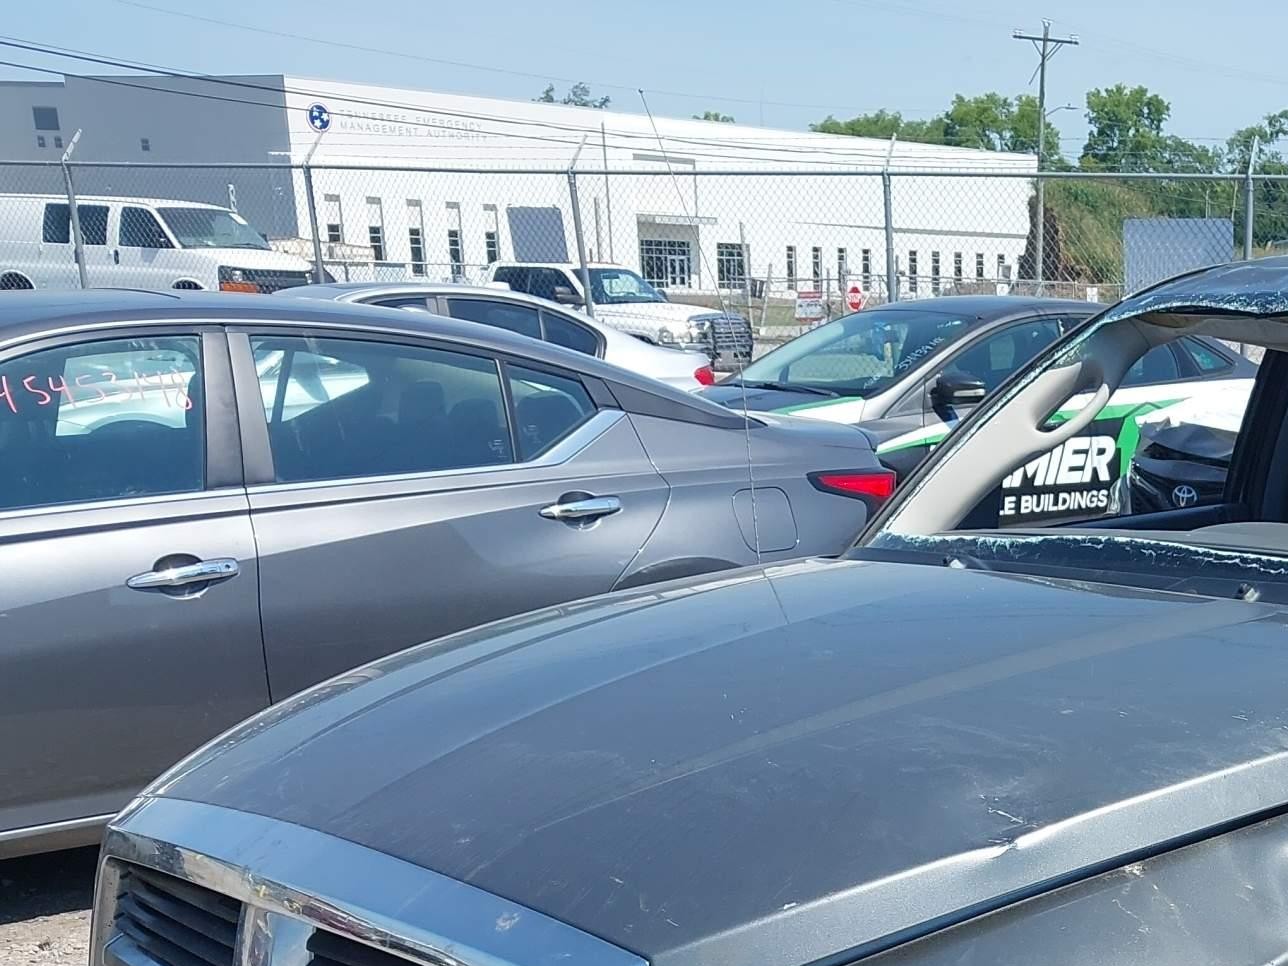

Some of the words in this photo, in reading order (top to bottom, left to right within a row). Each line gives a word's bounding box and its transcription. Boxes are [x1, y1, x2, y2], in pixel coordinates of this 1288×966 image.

[340, 120, 420, 136] MANAGEMENT
[425, 128, 489, 143] AUTHORITY
[1002, 435, 1116, 489] MIER
[1020, 489, 1109, 514] BUILDINGS
